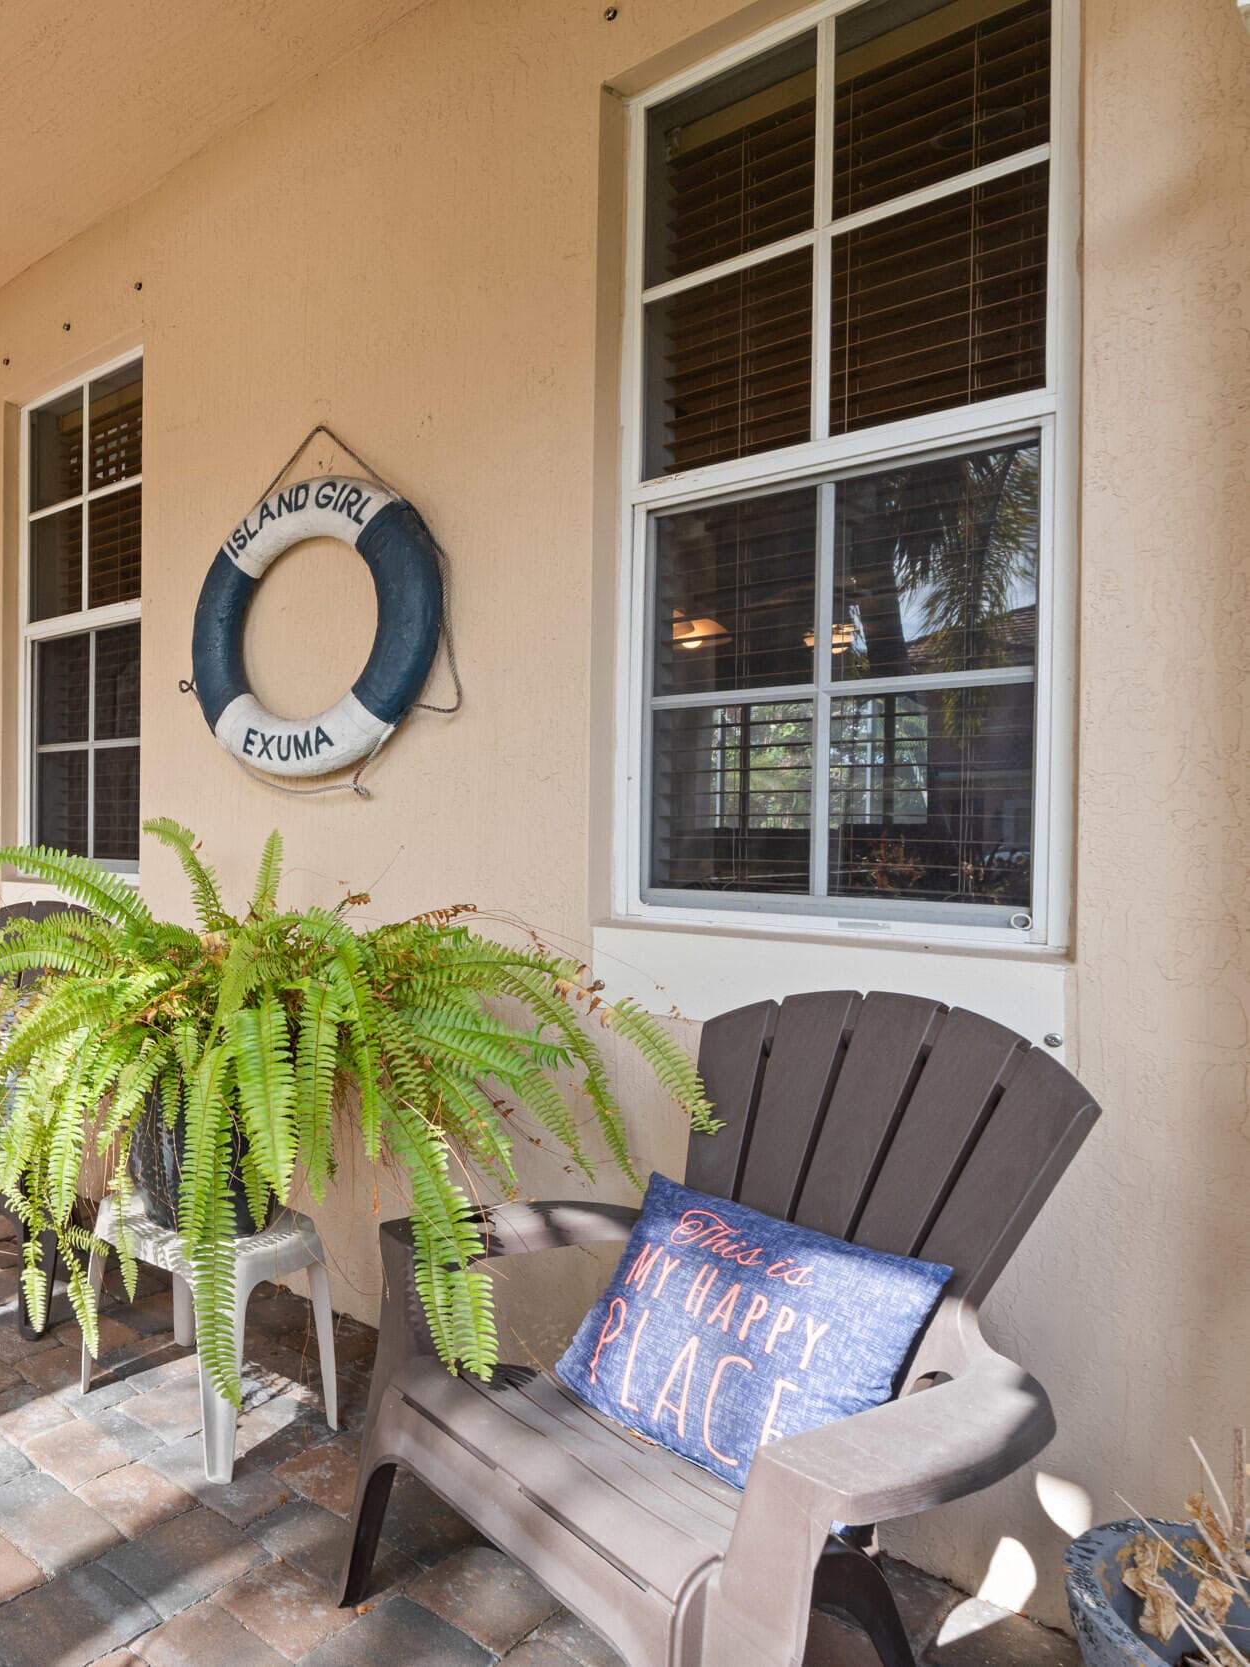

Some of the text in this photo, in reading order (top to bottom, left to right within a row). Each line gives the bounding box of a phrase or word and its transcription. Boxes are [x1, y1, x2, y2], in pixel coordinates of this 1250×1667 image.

[225, 480, 374, 559] ISLAND GIRL
[242, 726, 335, 762] EXUMA
[669, 1208, 815, 1288] This is
[624, 1242, 831, 1371] MY HAPPY
